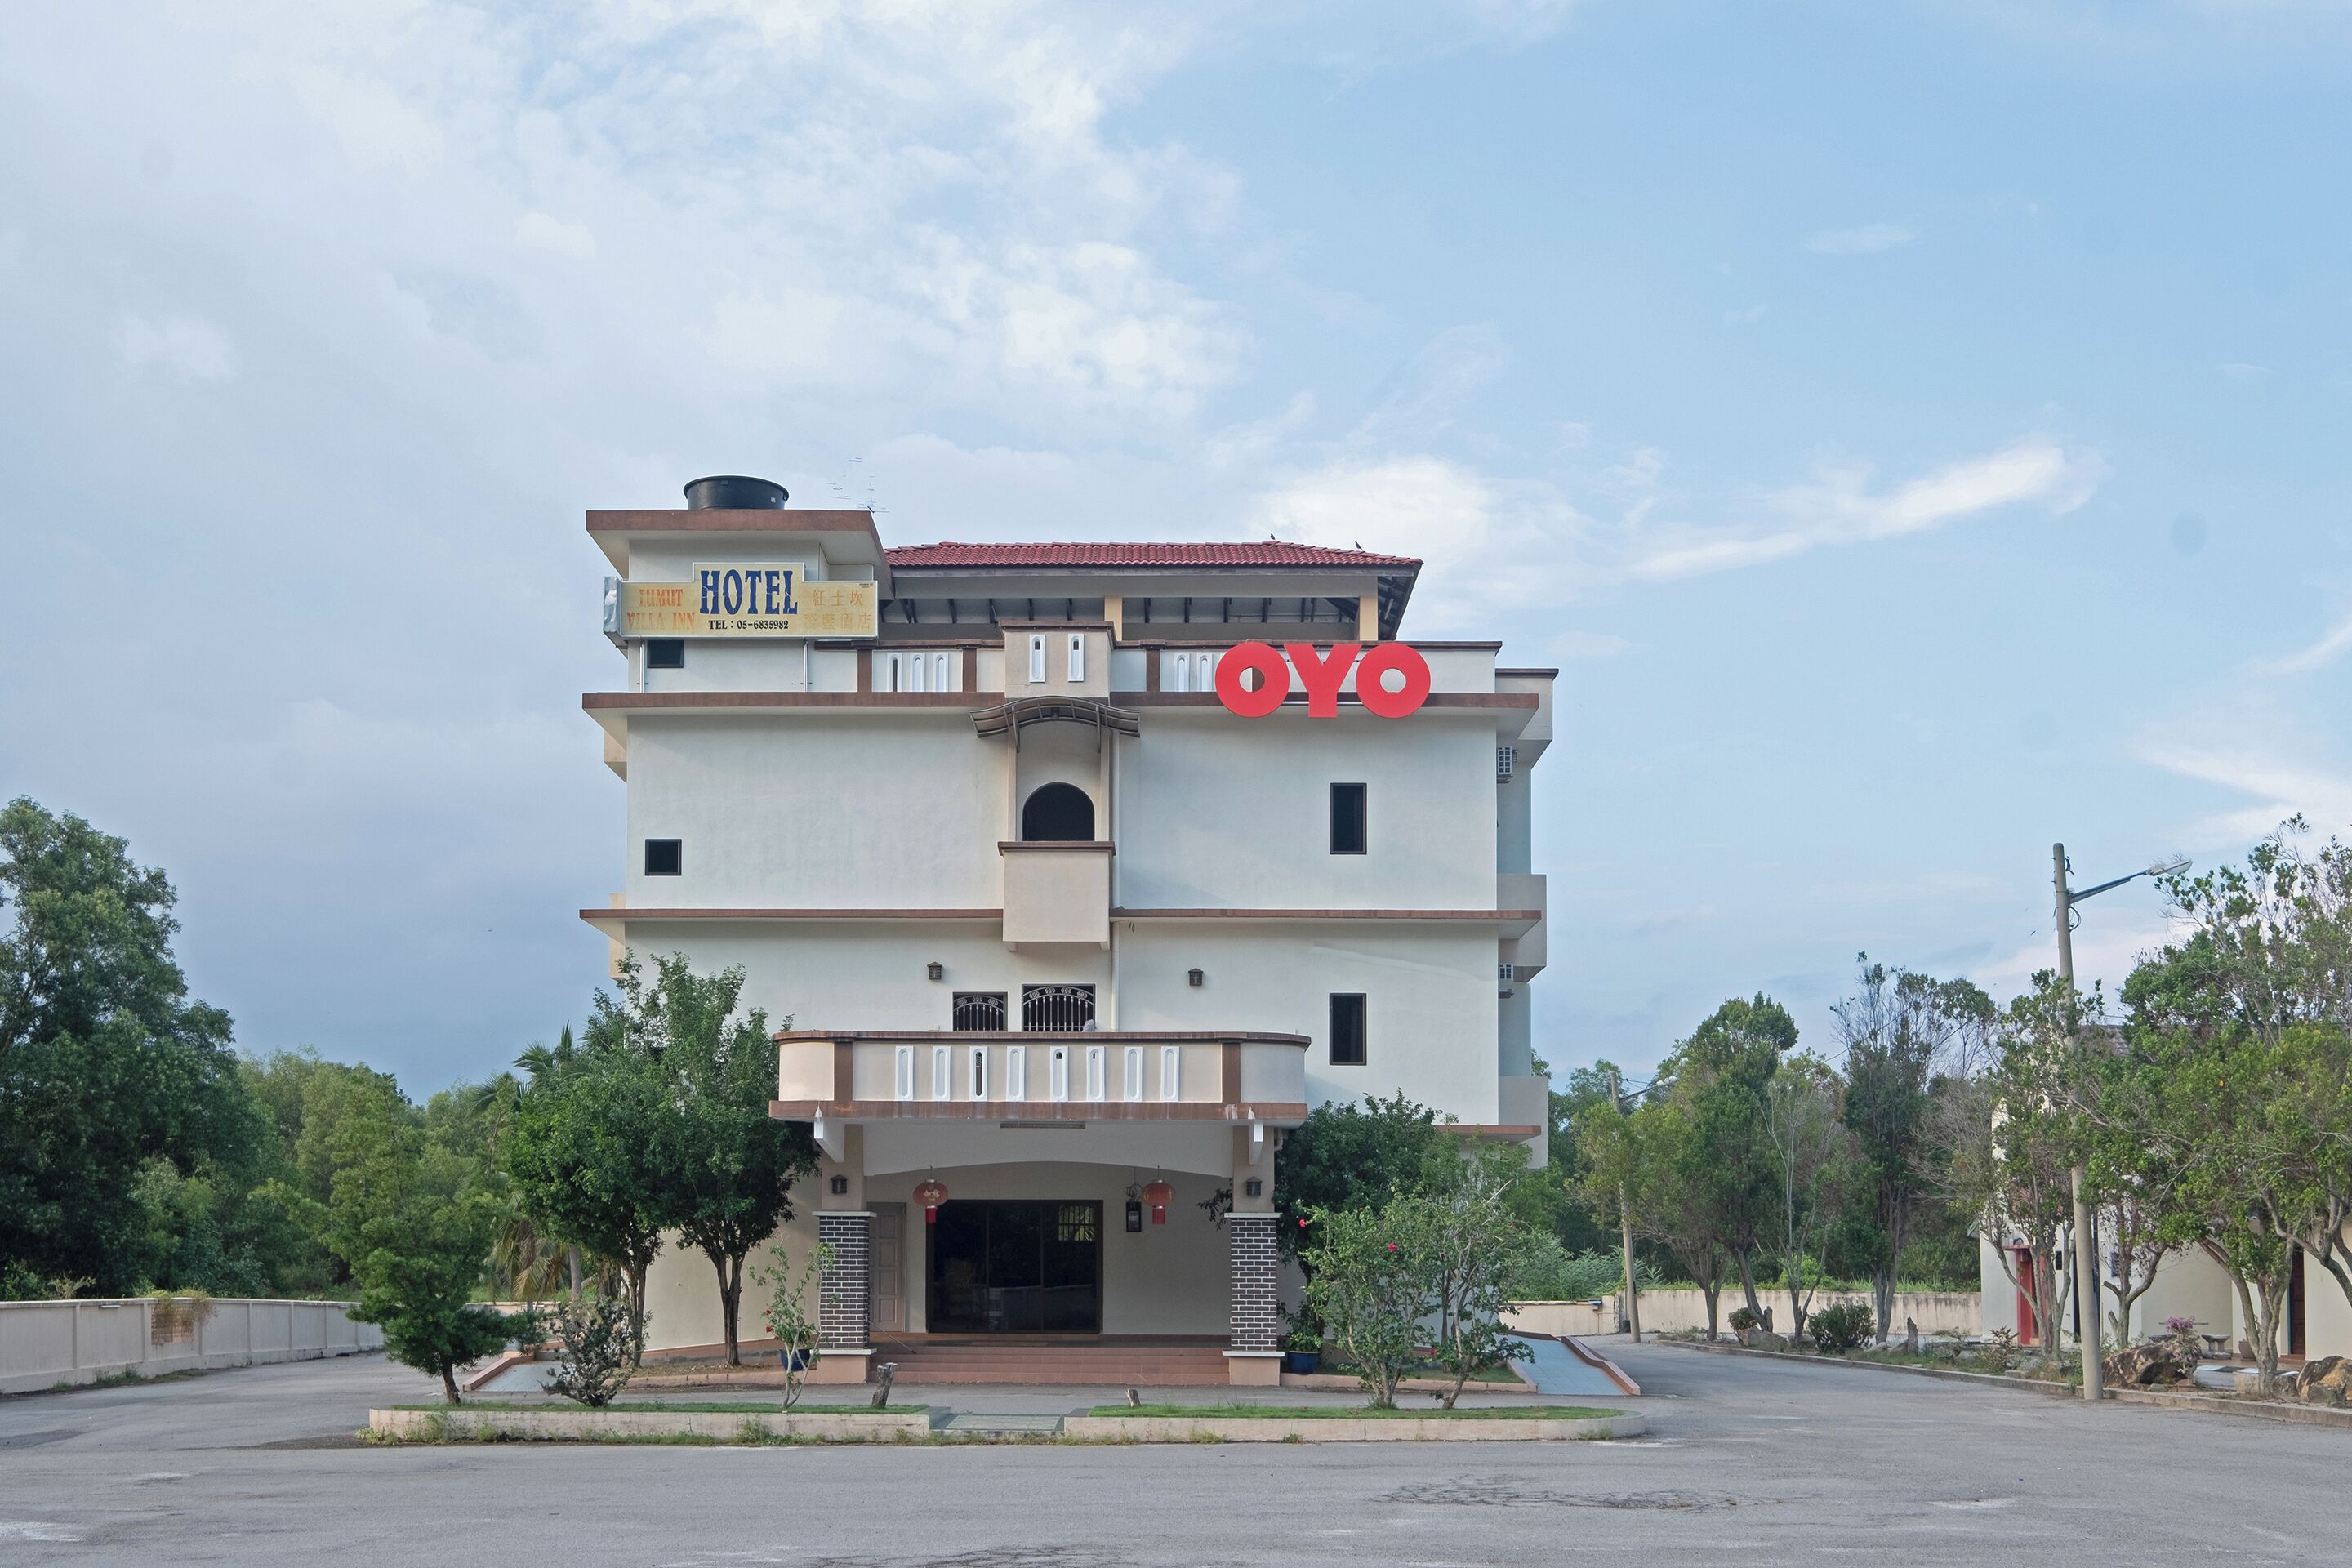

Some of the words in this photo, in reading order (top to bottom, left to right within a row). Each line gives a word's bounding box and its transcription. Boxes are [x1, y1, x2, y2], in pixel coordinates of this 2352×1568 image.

[639, 588, 683, 607] LUMUT
[700, 569, 797, 614] HOTEL
[627, 612, 665, 630] VILLA
[673, 612, 695, 630] INN
[737, 620, 789, 630] 05-6835982
[1215, 642, 1431, 719] OYO
